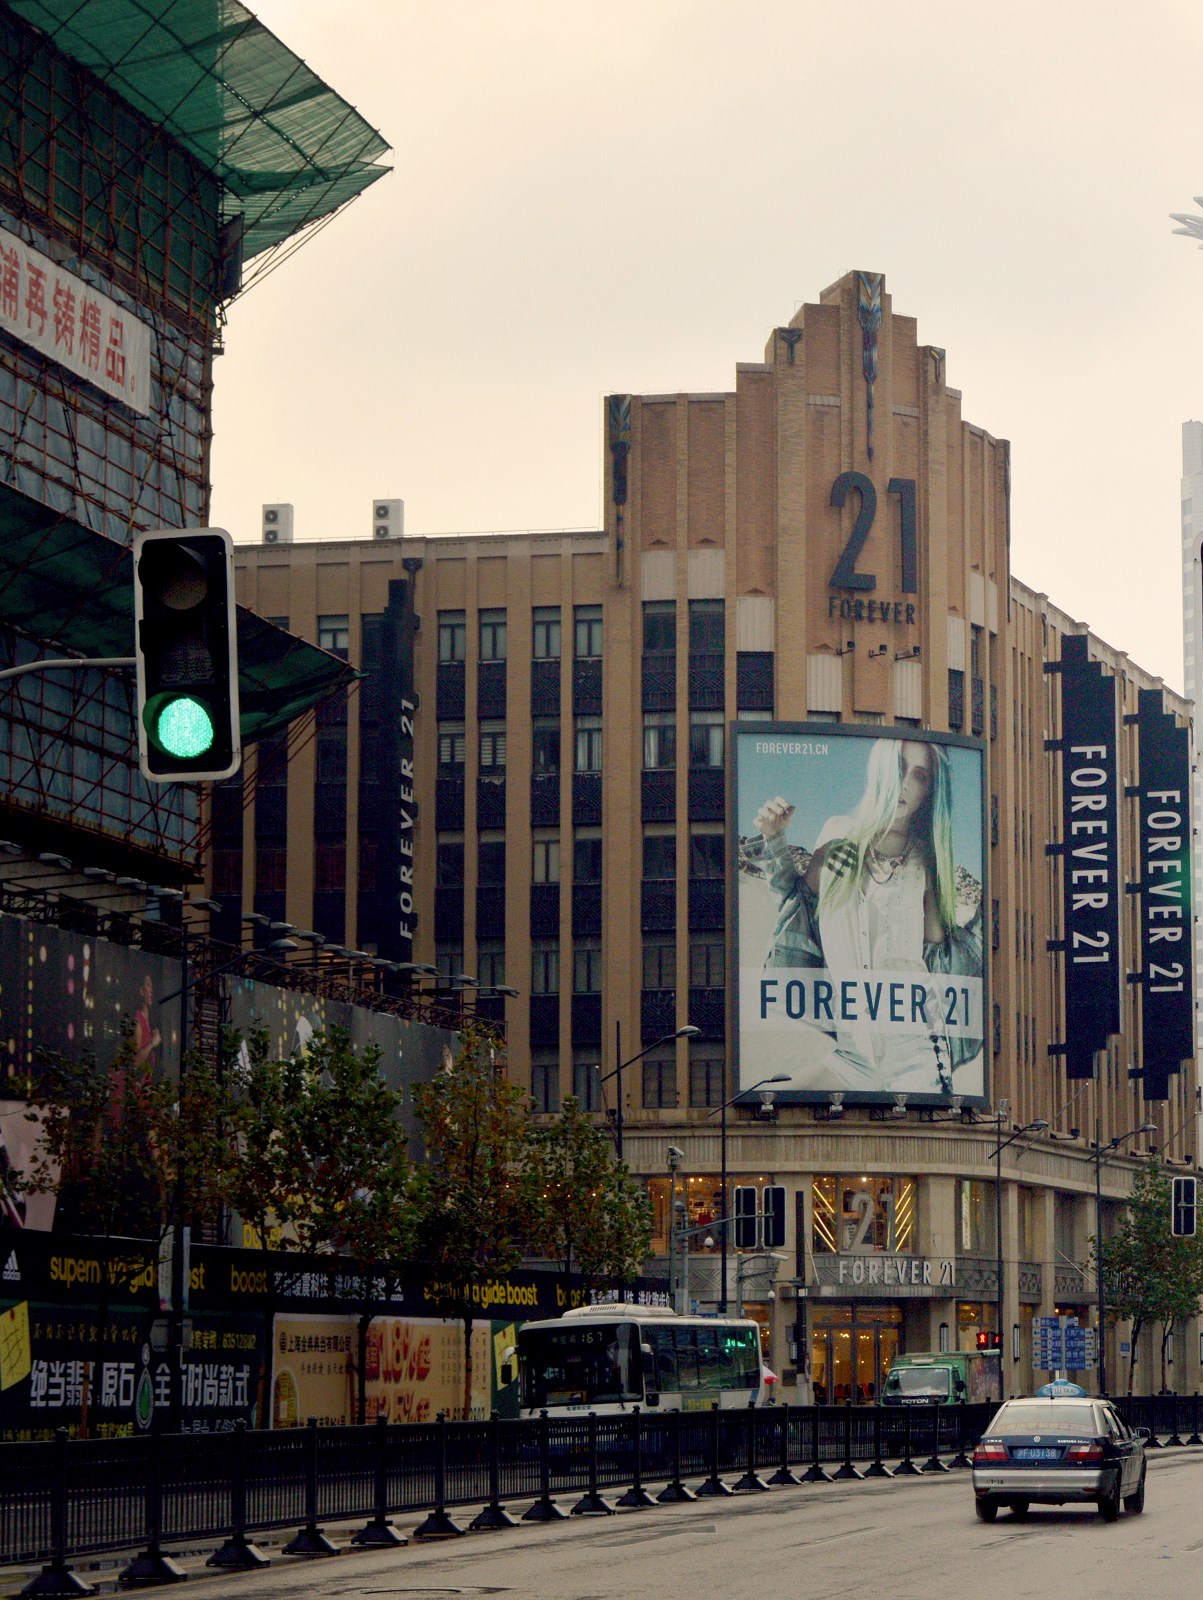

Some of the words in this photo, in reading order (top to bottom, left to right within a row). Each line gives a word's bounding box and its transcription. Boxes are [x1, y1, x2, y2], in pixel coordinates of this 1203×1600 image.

[829, 471, 917, 593] 21
[829, 596, 916, 625] FOREVER
[401, 699, 415, 737] 21
[755, 742, 829, 755] FOREVER21.CN
[1070, 744, 1109, 911] FOREVER
[399, 758, 415, 940] FOREVER
[1146, 789, 1182, 944] FOREVER
[1073, 931, 1110, 964] 21
[1149, 962, 1184, 993] 21
[760, 979, 928, 1023] FOREVER
[944, 986, 970, 1027] 21
[230, 1264, 269, 1293] boost
[839, 1259, 931, 1285] FOREVER
[940, 1261, 956, 1287] 21
[506, 1280, 539, 1306] boost
